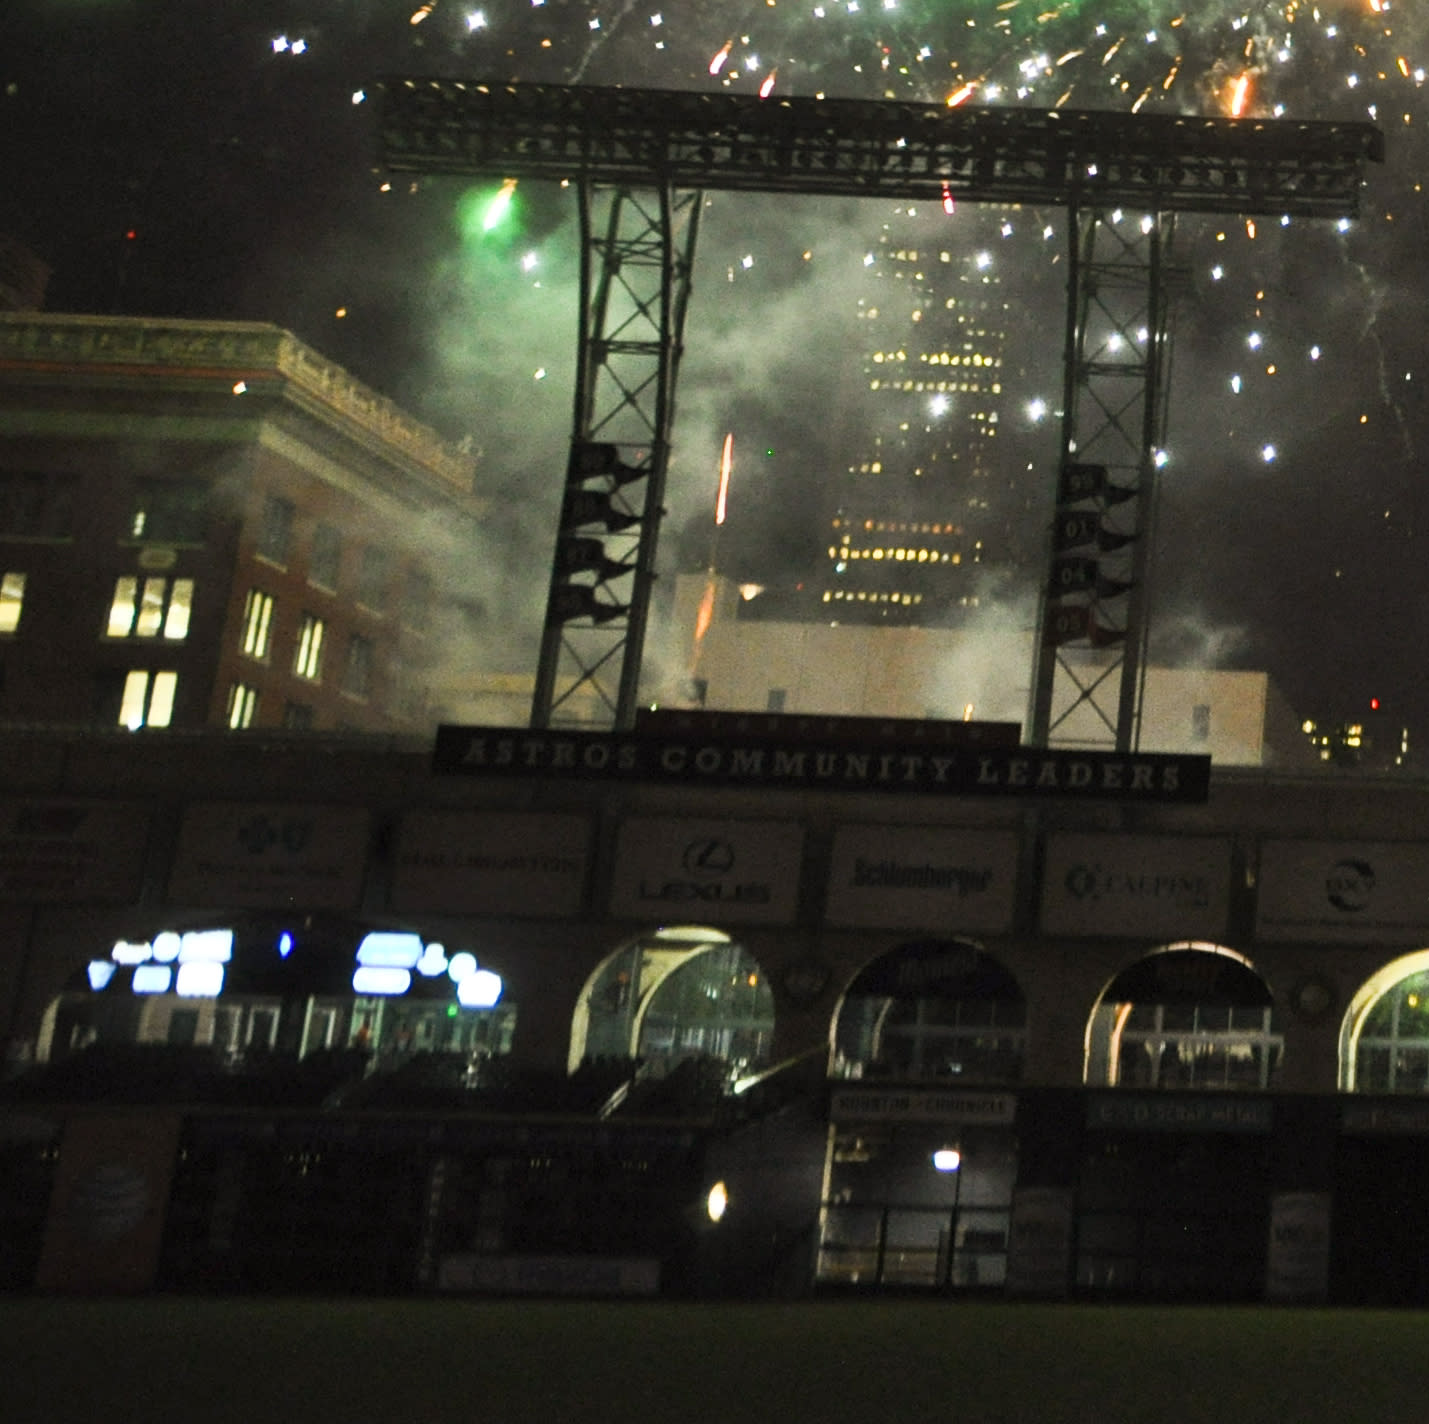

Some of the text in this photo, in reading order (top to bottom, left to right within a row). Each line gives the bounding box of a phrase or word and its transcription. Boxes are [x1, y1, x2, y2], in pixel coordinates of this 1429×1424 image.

[463, 736, 1184, 795] ASTROS COMMUNITY LEADERS
[639, 879, 771, 903] LEXUS
